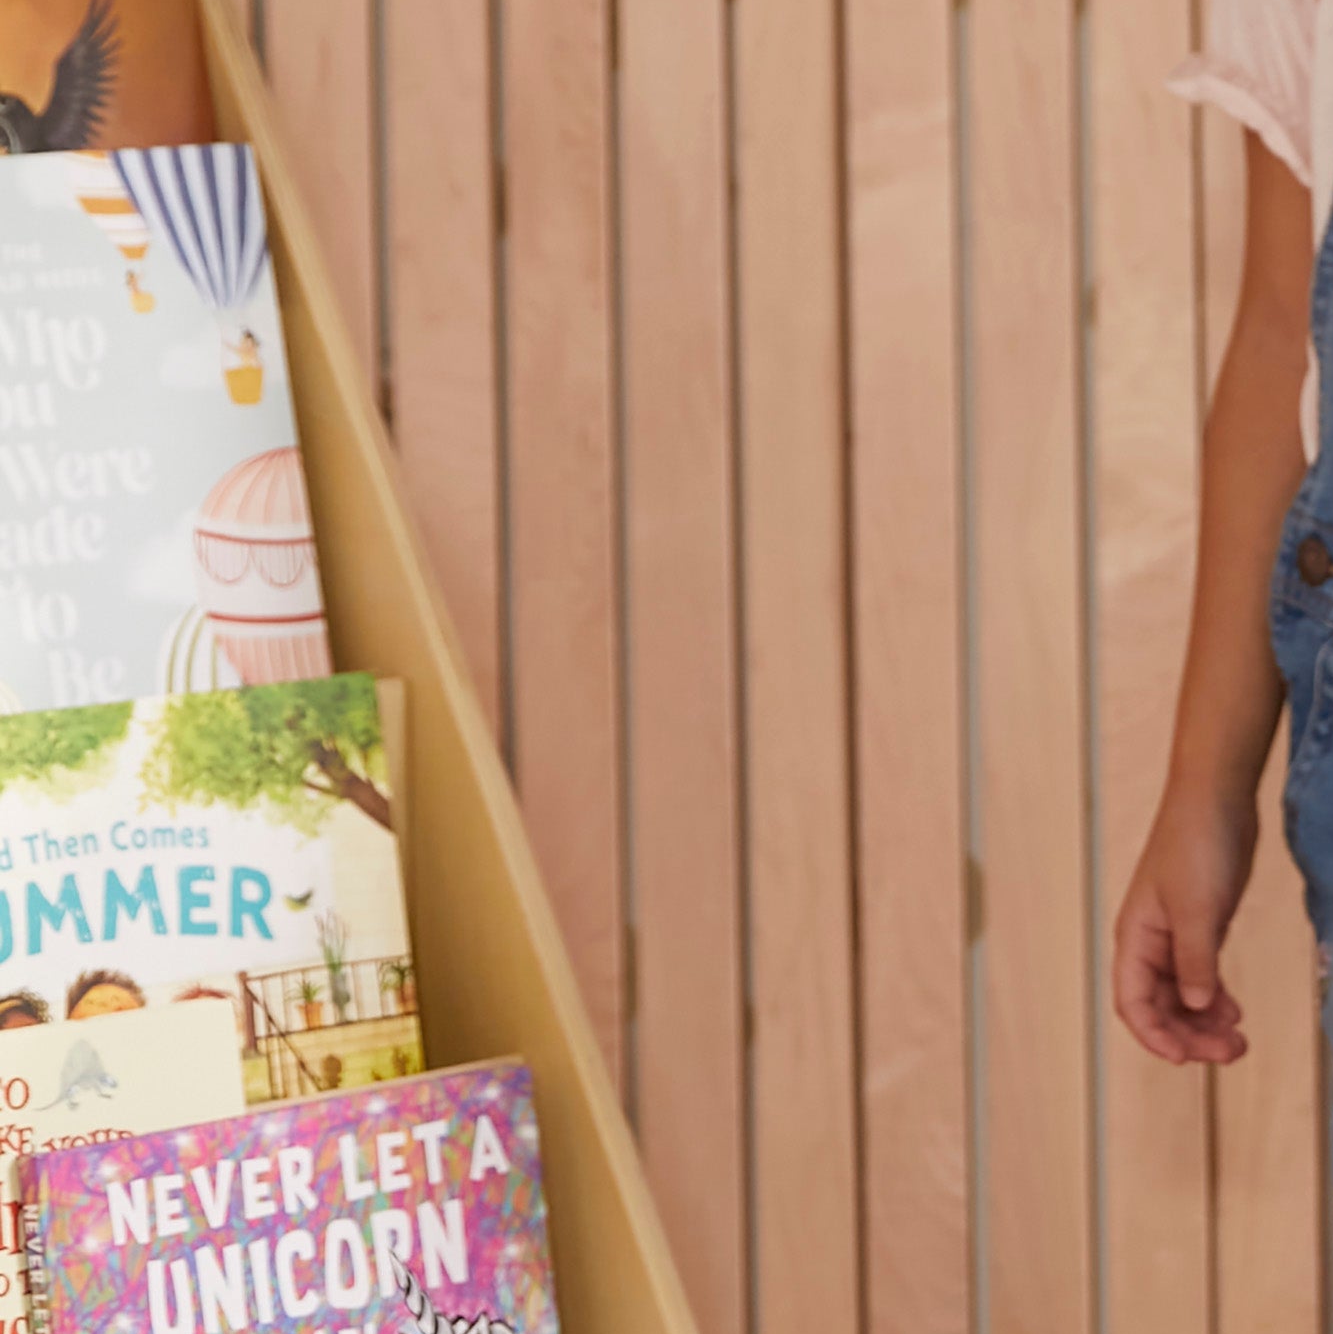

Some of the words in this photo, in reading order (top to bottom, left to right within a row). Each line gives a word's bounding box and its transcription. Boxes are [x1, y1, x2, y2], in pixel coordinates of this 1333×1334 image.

[22, 831, 99, 864] Then
[110, 821, 210, 851] Comes
[107, 1146, 316, 1246] NEVER
[338, 1120, 449, 1202] LET
[469, 1114, 510, 1181] A
[22, 1204, 45, 1283] NEVER
[31, 1293, 51, 1334] LET
